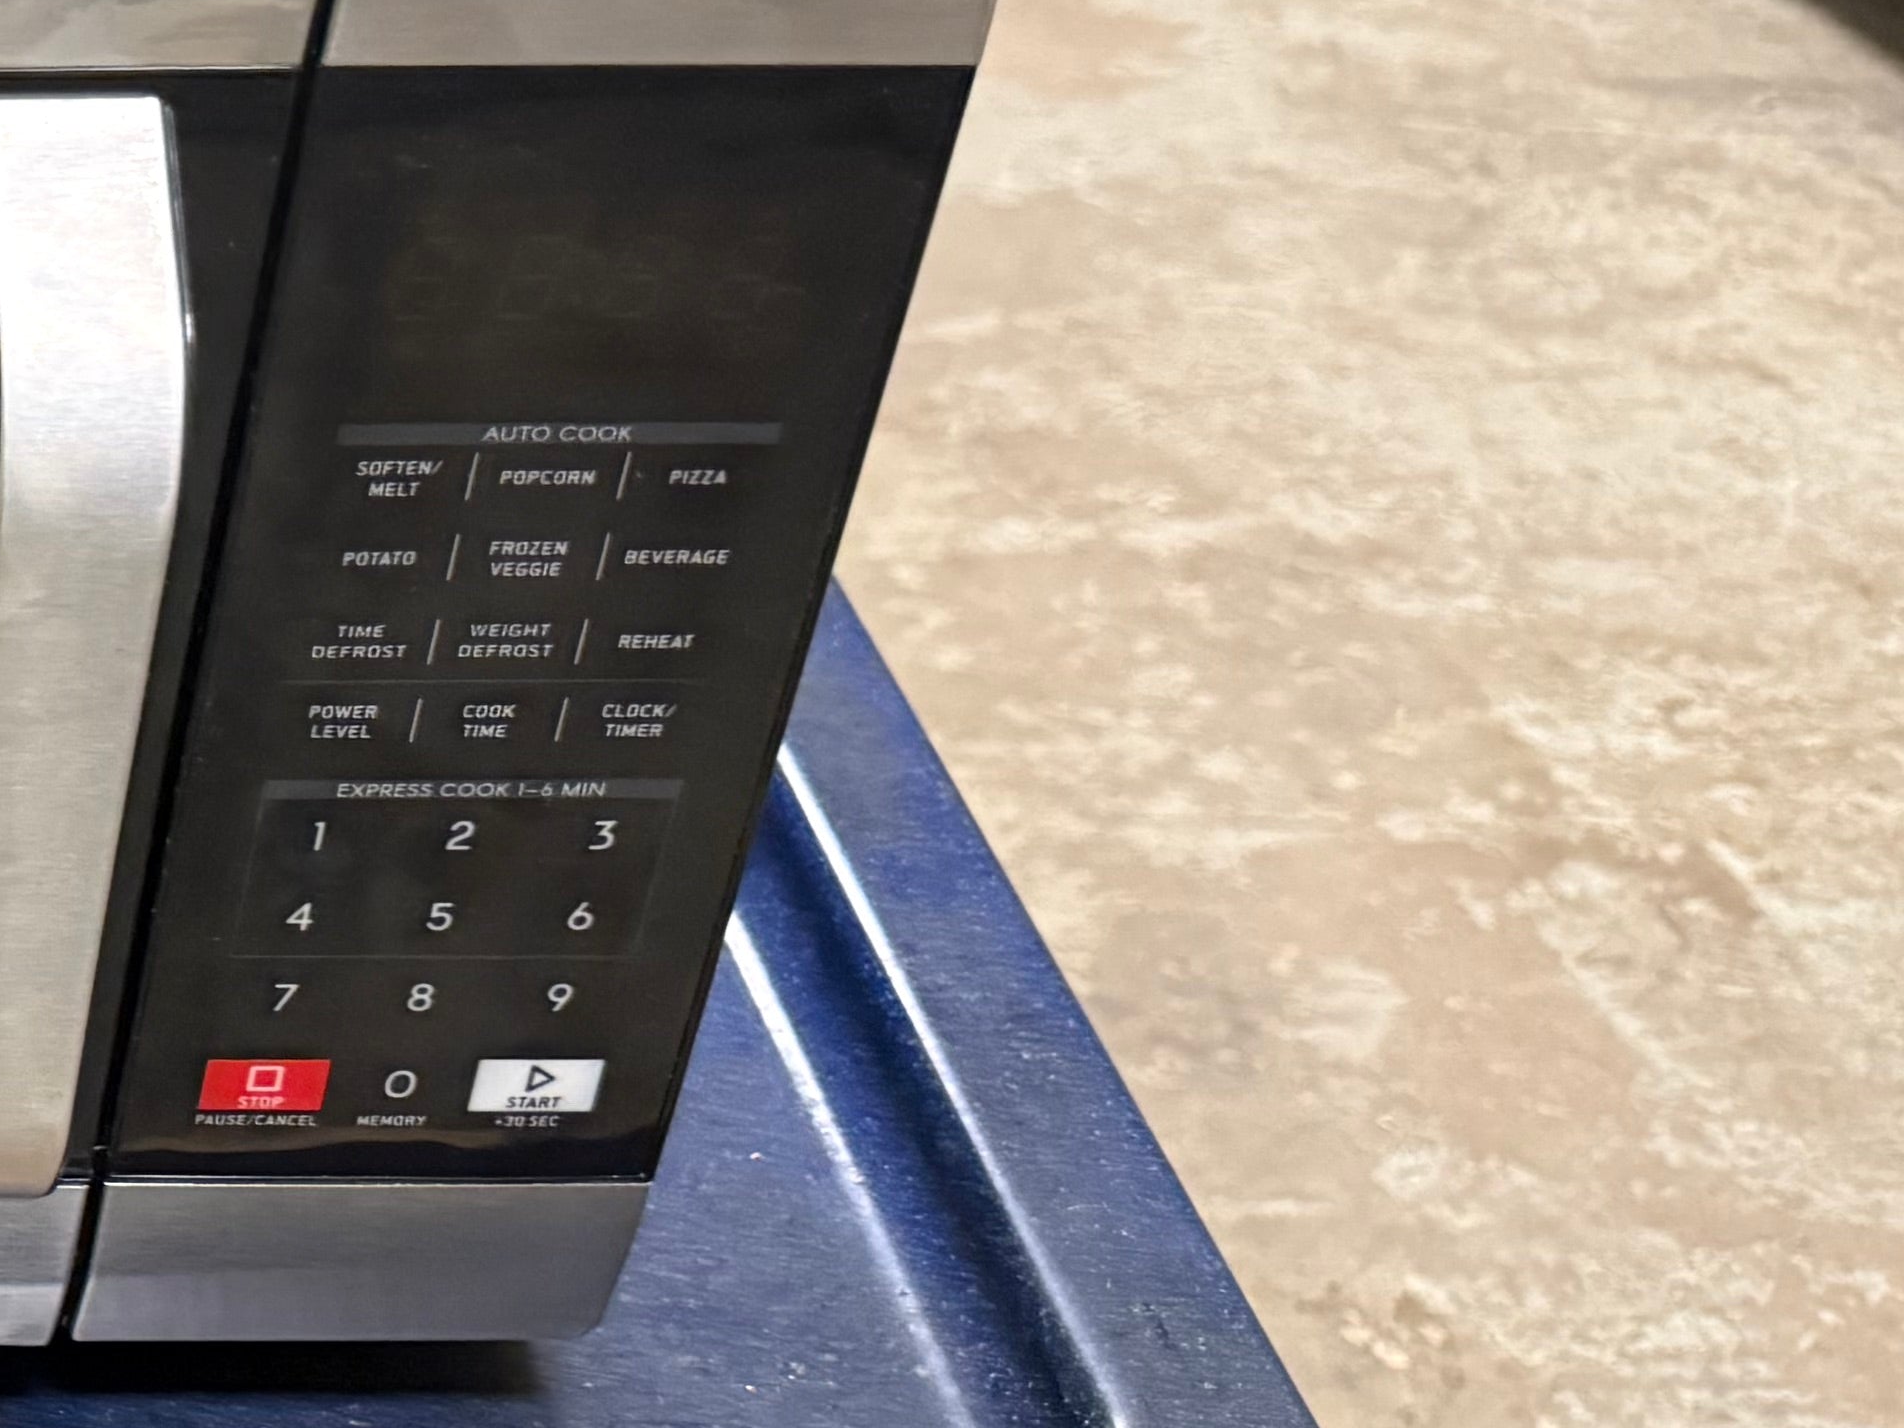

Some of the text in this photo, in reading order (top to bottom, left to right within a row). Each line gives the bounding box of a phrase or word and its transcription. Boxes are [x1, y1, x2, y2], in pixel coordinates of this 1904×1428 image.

[482, 426, 633, 442] AUTO COOK
[355, 460, 443, 476] SOFTEN/
[499, 470, 596, 485] POPCORN
[668, 469, 728, 485] PIZZA
[367, 482, 420, 497] MELT
[489, 541, 569, 557] FROZEN
[342, 552, 416, 566] POTATO
[624, 550, 730, 566] BEVERAGE
[489, 562, 563, 578] VEGGIE
[337, 624, 387, 638] TIME
[469, 623, 551, 638] WEIGHT
[617, 634, 695, 649] REHEAT
[311, 645, 407, 659] DEFROST
[457, 644, 554, 659] DEFROST
[308, 705, 378, 719] POWER
[462, 704, 516, 719] COOK
[602, 703, 678, 719] CLOCK/
[310, 725, 372, 740] LEVEL
[463, 724, 508, 739] TIME
[605, 723, 665, 738] TIMER
[336, 783, 434, 798] EXPRESS
[440, 782, 507, 798] COOK
[561, 782, 606, 797] MIN
[312, 821, 326, 851] 1
[445, 820, 476, 850] 2
[588, 820, 618, 850] 3
[287, 902, 314, 931] 4
[426, 902, 455, 931] 5
[567, 902, 595, 931] 6
[272, 984, 299, 1012] 7
[406, 983, 436, 1012] 8
[547, 983, 575, 1012] 9
[237, 1095, 284, 1109] STOP
[505, 1096, 562, 1109] START
[194, 1114, 318, 1126] PAUSE/CANCEL
[356, 1115, 427, 1126] MEMORY
[528, 1115, 560, 1127] SEC
